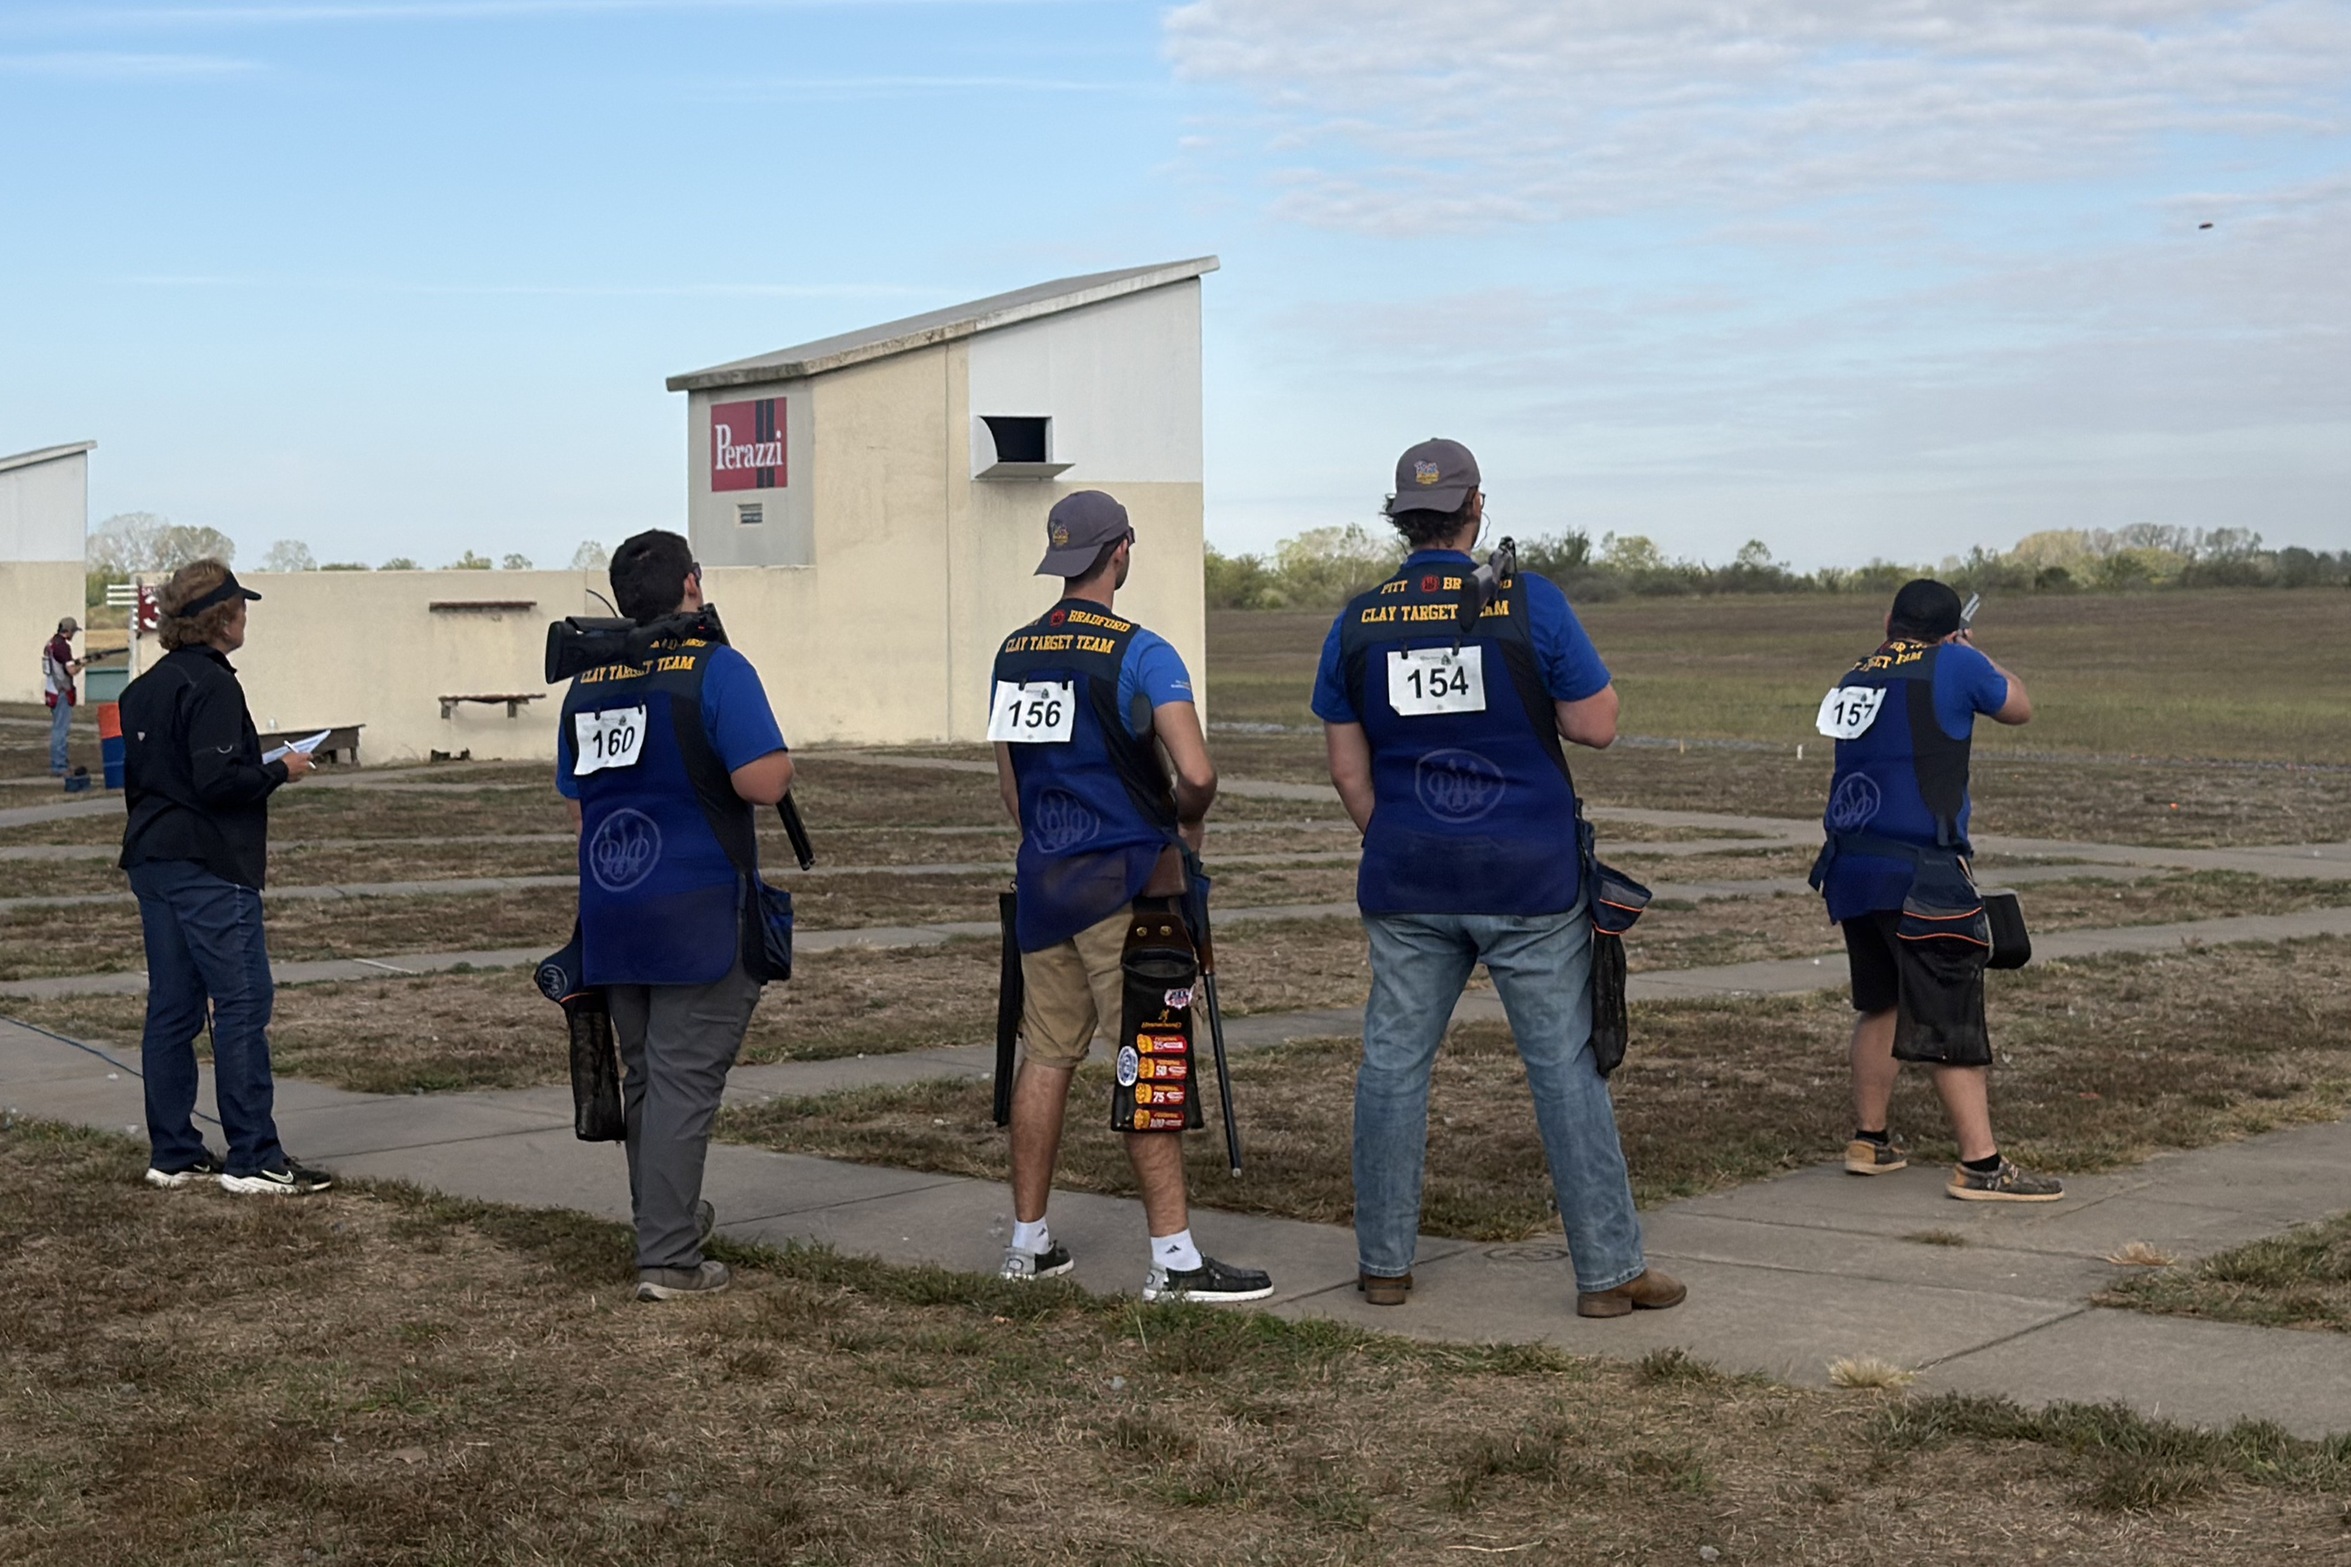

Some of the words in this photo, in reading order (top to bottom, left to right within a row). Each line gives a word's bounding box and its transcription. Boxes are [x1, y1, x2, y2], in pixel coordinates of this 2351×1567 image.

[715, 424, 783, 470] Perazzi
[1381, 580, 1408, 595] PITT
[1067, 610, 1131, 633] BRADFORD
[1361, 606, 1397, 623] CLAY
[1401, 604, 1458, 621] TARGET
[1479, 600, 1510, 618] AM
[1005, 636, 1028, 653] CLAY
[1030, 634, 1074, 650] TARGET
[1076, 635, 1115, 654] TEAM
[657, 655, 696, 672] TEAM
[1407, 665, 1469, 699] 154
[1008, 700, 1062, 728] 156
[1834, 701, 1875, 726] 157
[593, 726, 635, 759] 160
[1153, 1091, 1165, 1103] 75
